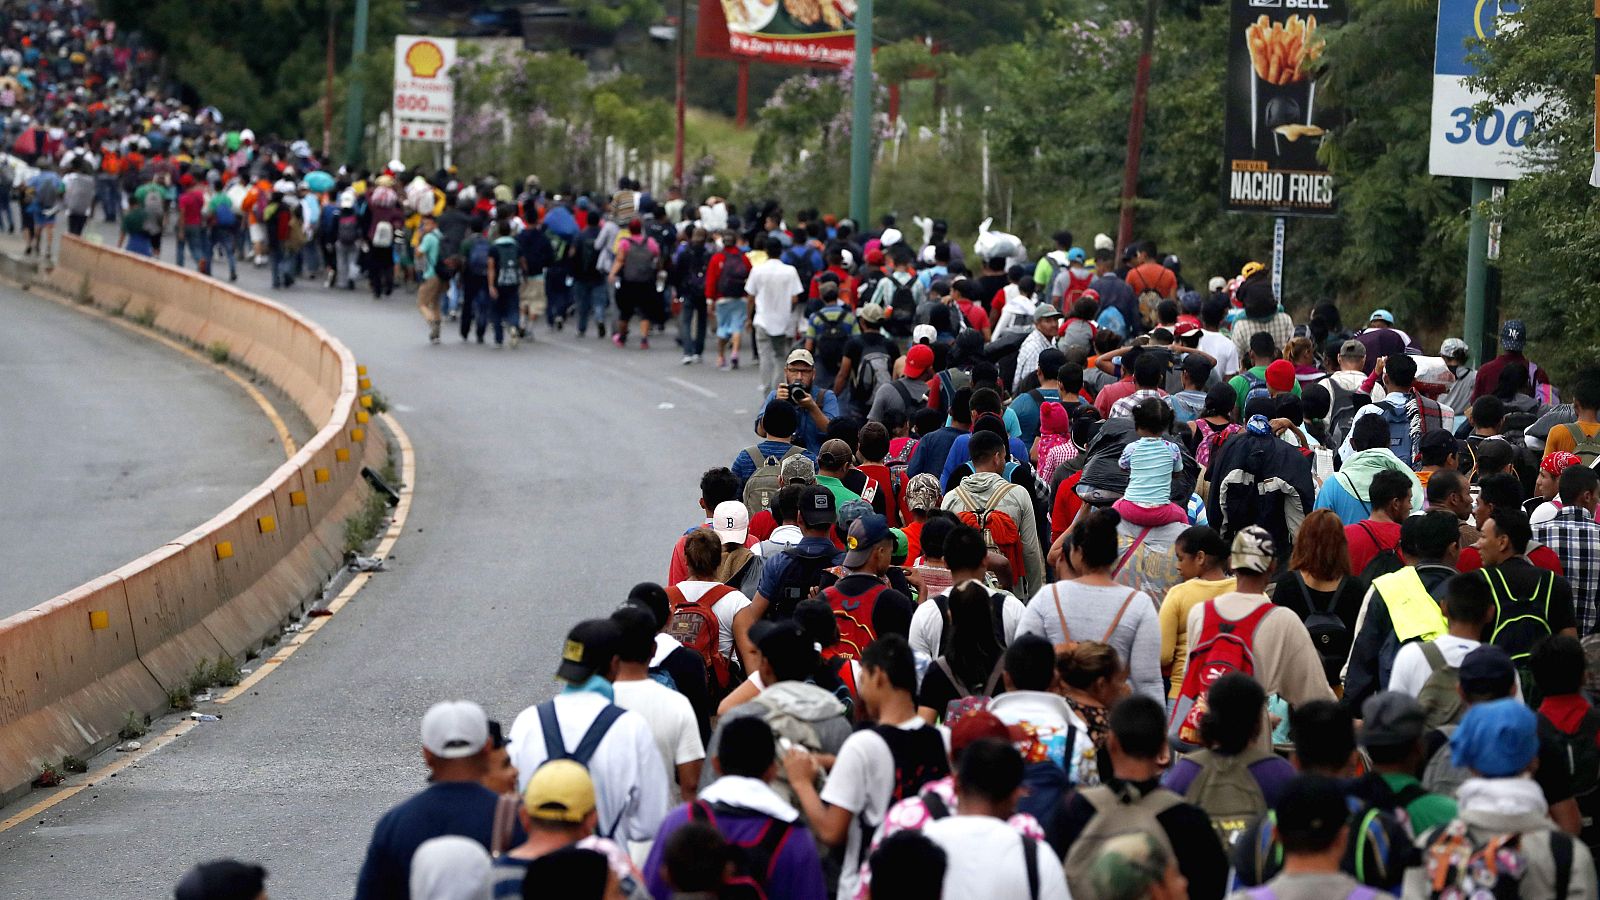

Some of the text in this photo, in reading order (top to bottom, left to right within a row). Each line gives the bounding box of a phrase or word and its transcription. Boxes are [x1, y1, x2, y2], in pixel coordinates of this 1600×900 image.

[1286, 0, 1329, 9] BELL
[397, 94, 429, 111] 800
[1445, 107, 1535, 148] 300
[1230, 171, 1333, 204] NACHO FRIES
[726, 517, 734, 528] B
